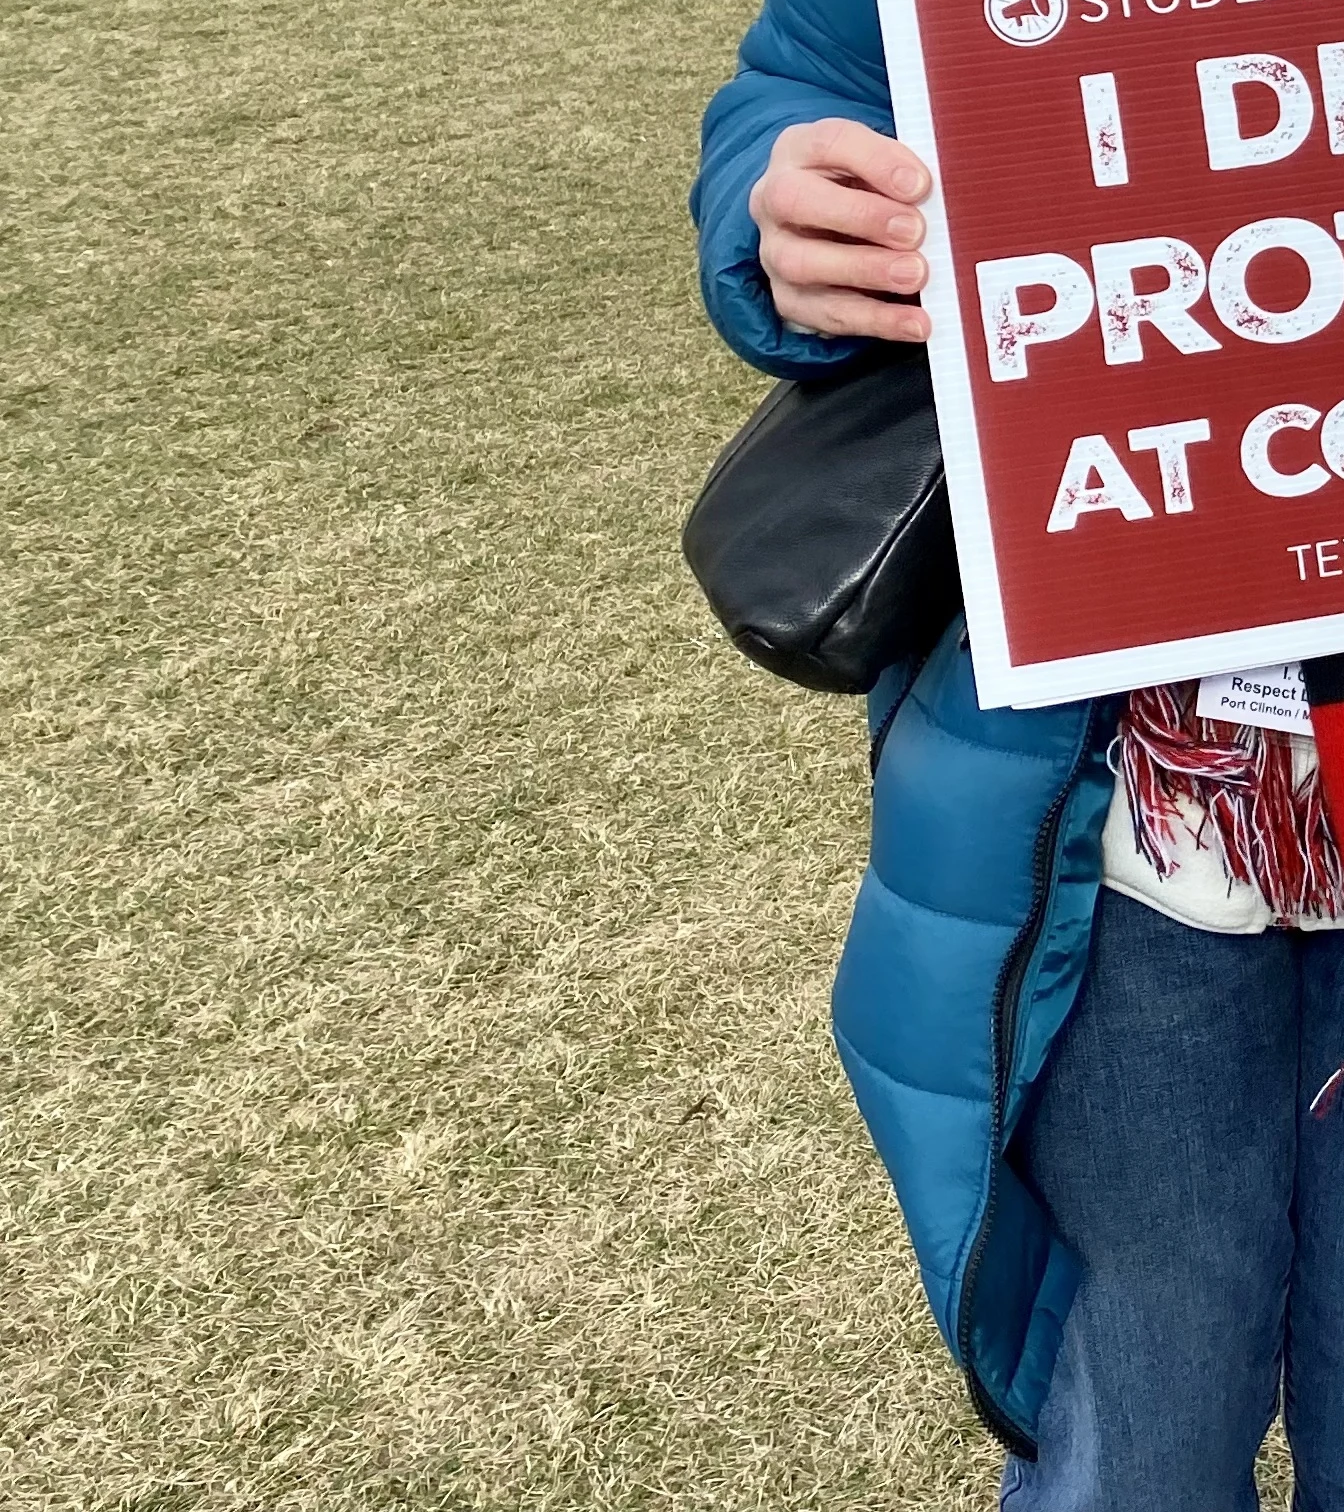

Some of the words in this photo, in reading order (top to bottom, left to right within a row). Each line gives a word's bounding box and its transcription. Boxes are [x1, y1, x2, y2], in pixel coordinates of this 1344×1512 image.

[1079, 71, 1130, 188] I
[1046, 418, 1211, 534] AT
[1220, 696, 1246, 709] Port
[1249, 700, 1292, 718] Clinton
[1232, 676, 1296, 701] Respect
